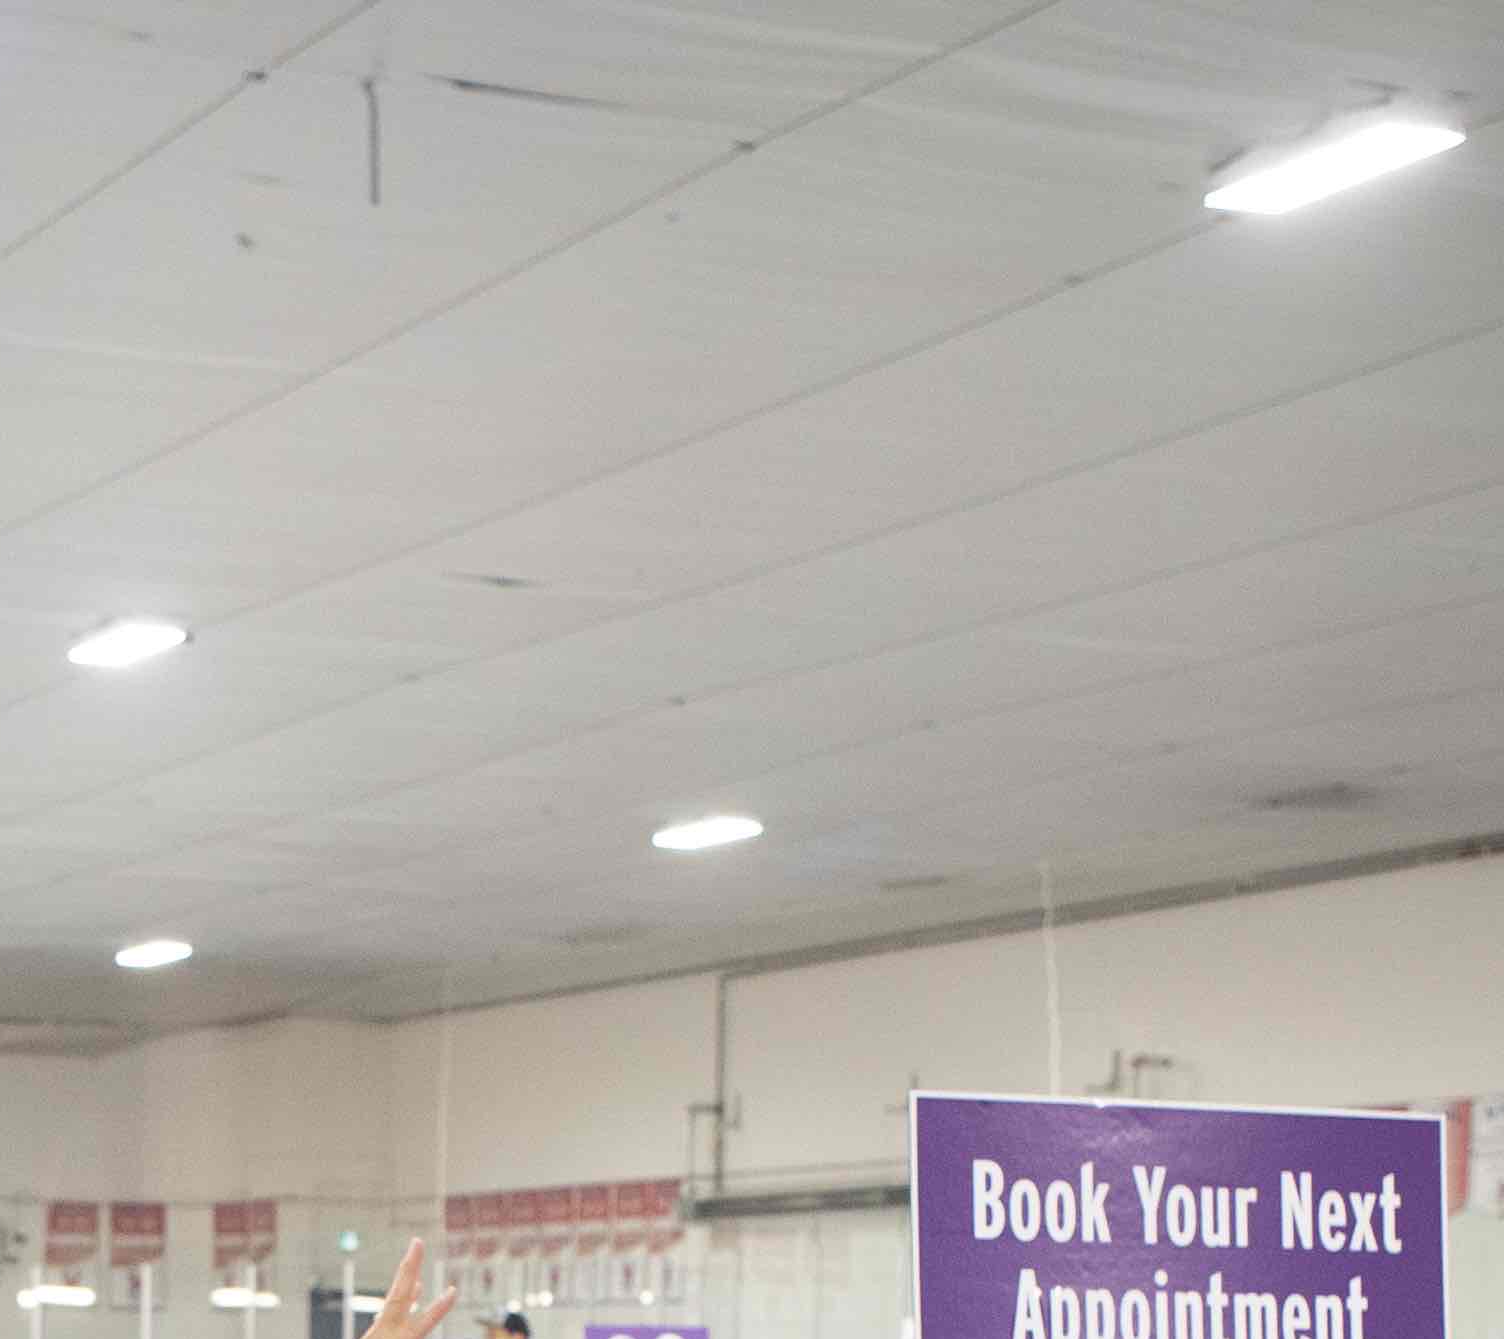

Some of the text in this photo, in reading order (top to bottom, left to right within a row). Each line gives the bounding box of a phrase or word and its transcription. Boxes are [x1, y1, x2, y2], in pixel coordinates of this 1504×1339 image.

[974, 1161, 1402, 1254] Book Your Next
